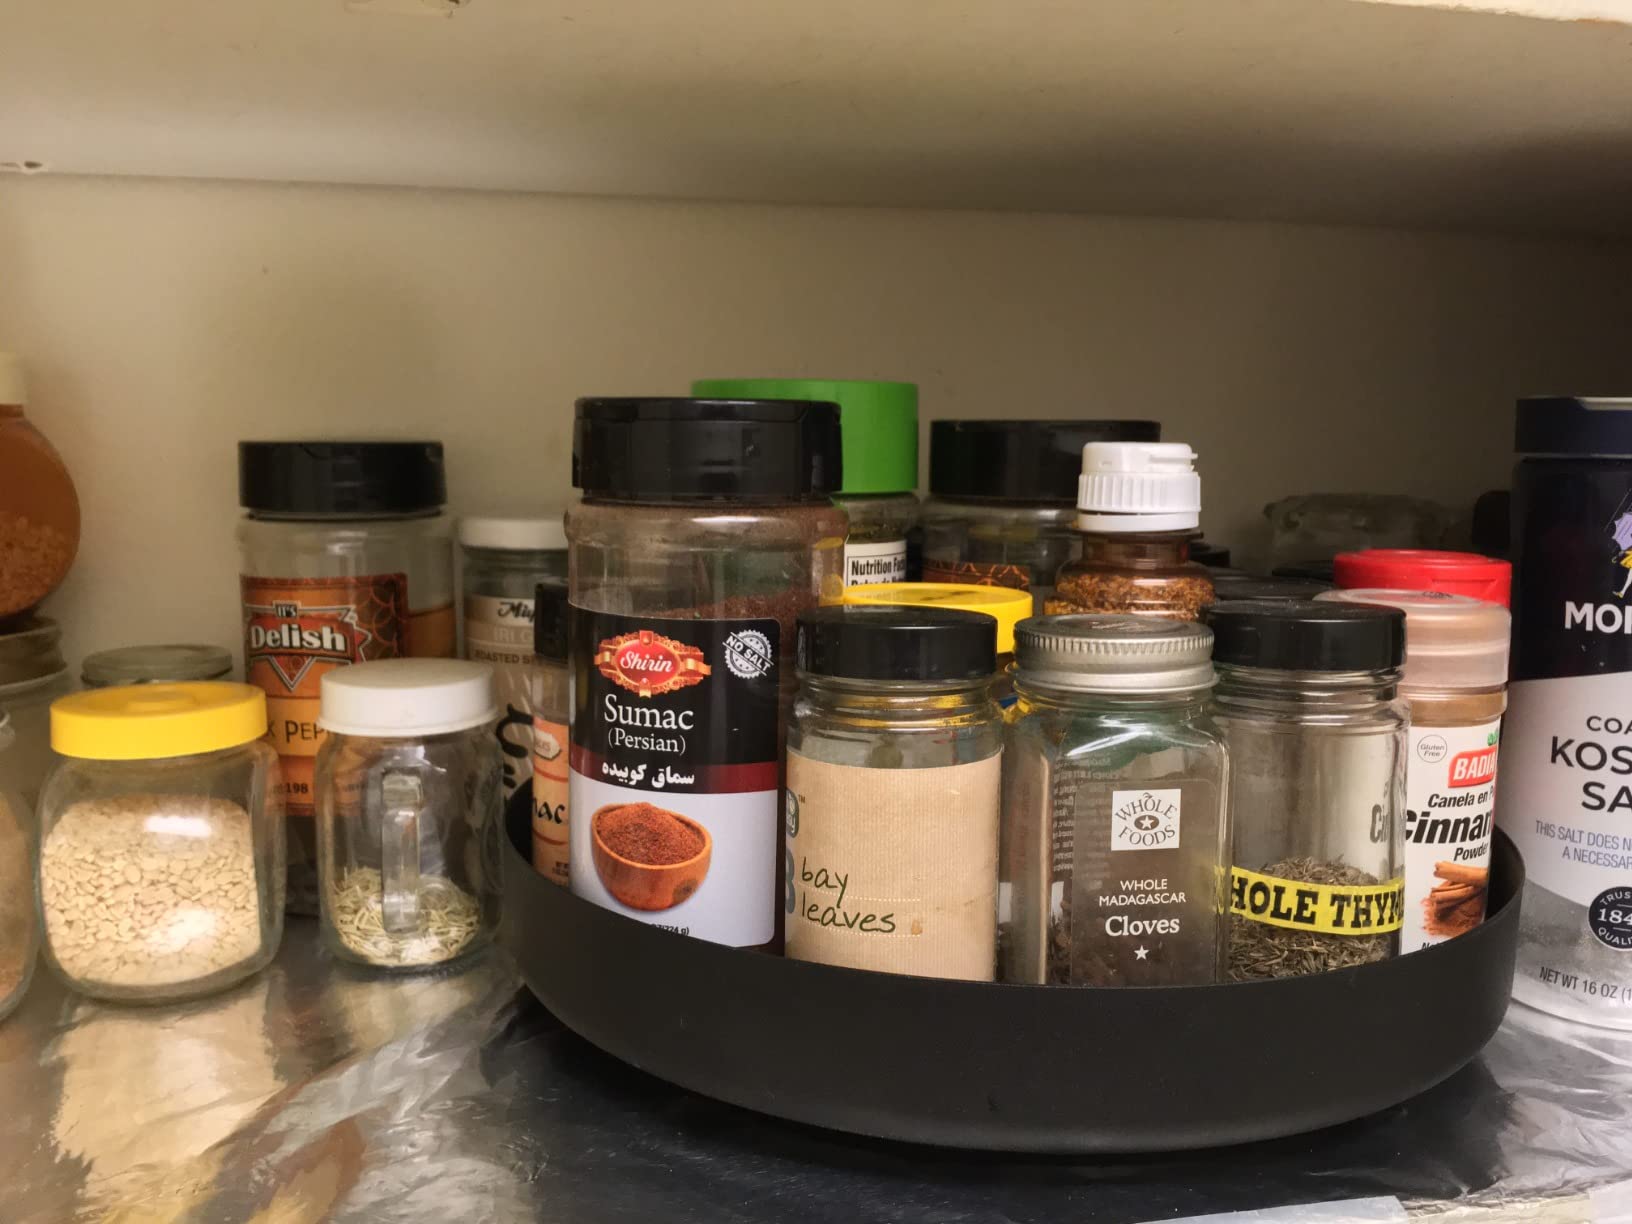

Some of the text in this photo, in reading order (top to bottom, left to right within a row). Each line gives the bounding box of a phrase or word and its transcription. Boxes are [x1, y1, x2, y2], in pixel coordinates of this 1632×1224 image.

[850, 558, 893, 577] Nutrition
[250, 623, 345, 652] Delish
[619, 650, 674, 673] Shirin
[725, 634, 771, 672] NO SALT
[603, 693, 695, 730] Sumac
[607, 727, 687, 756] (Persian)
[1419, 742, 1445, 751] Gluten
[1423, 750, 1441, 758] Free
[1550, 735, 1632, 776] KOS
[651, 765, 695, 789] سماق
[1114, 791, 1178, 822] WHOLE
[1427, 791, 1475, 809] Canela
[1581, 780, 1632, 814] SA
[1117, 824, 1176, 847] FOODS
[1535, 819, 1556, 838] THIS
[1557, 825, 1584, 844] SALT
[1587, 832, 1619, 851] DOES
[1562, 845, 1571, 859] A
[801, 855, 849, 909] bay
[1120, 878, 1169, 892] WHOLE
[1098, 892, 1187, 907] MADAGASCAR
[1599, 891, 1632, 906] TRUS
[801, 891, 896, 933] leaves
[1104, 915, 1181, 937] Cloves
[1539, 966, 1561, 984] NET
[1562, 972, 1580, 990] WT
[1582, 978, 1598, 995] 16
[1600, 983, 1618, 999] OZ
